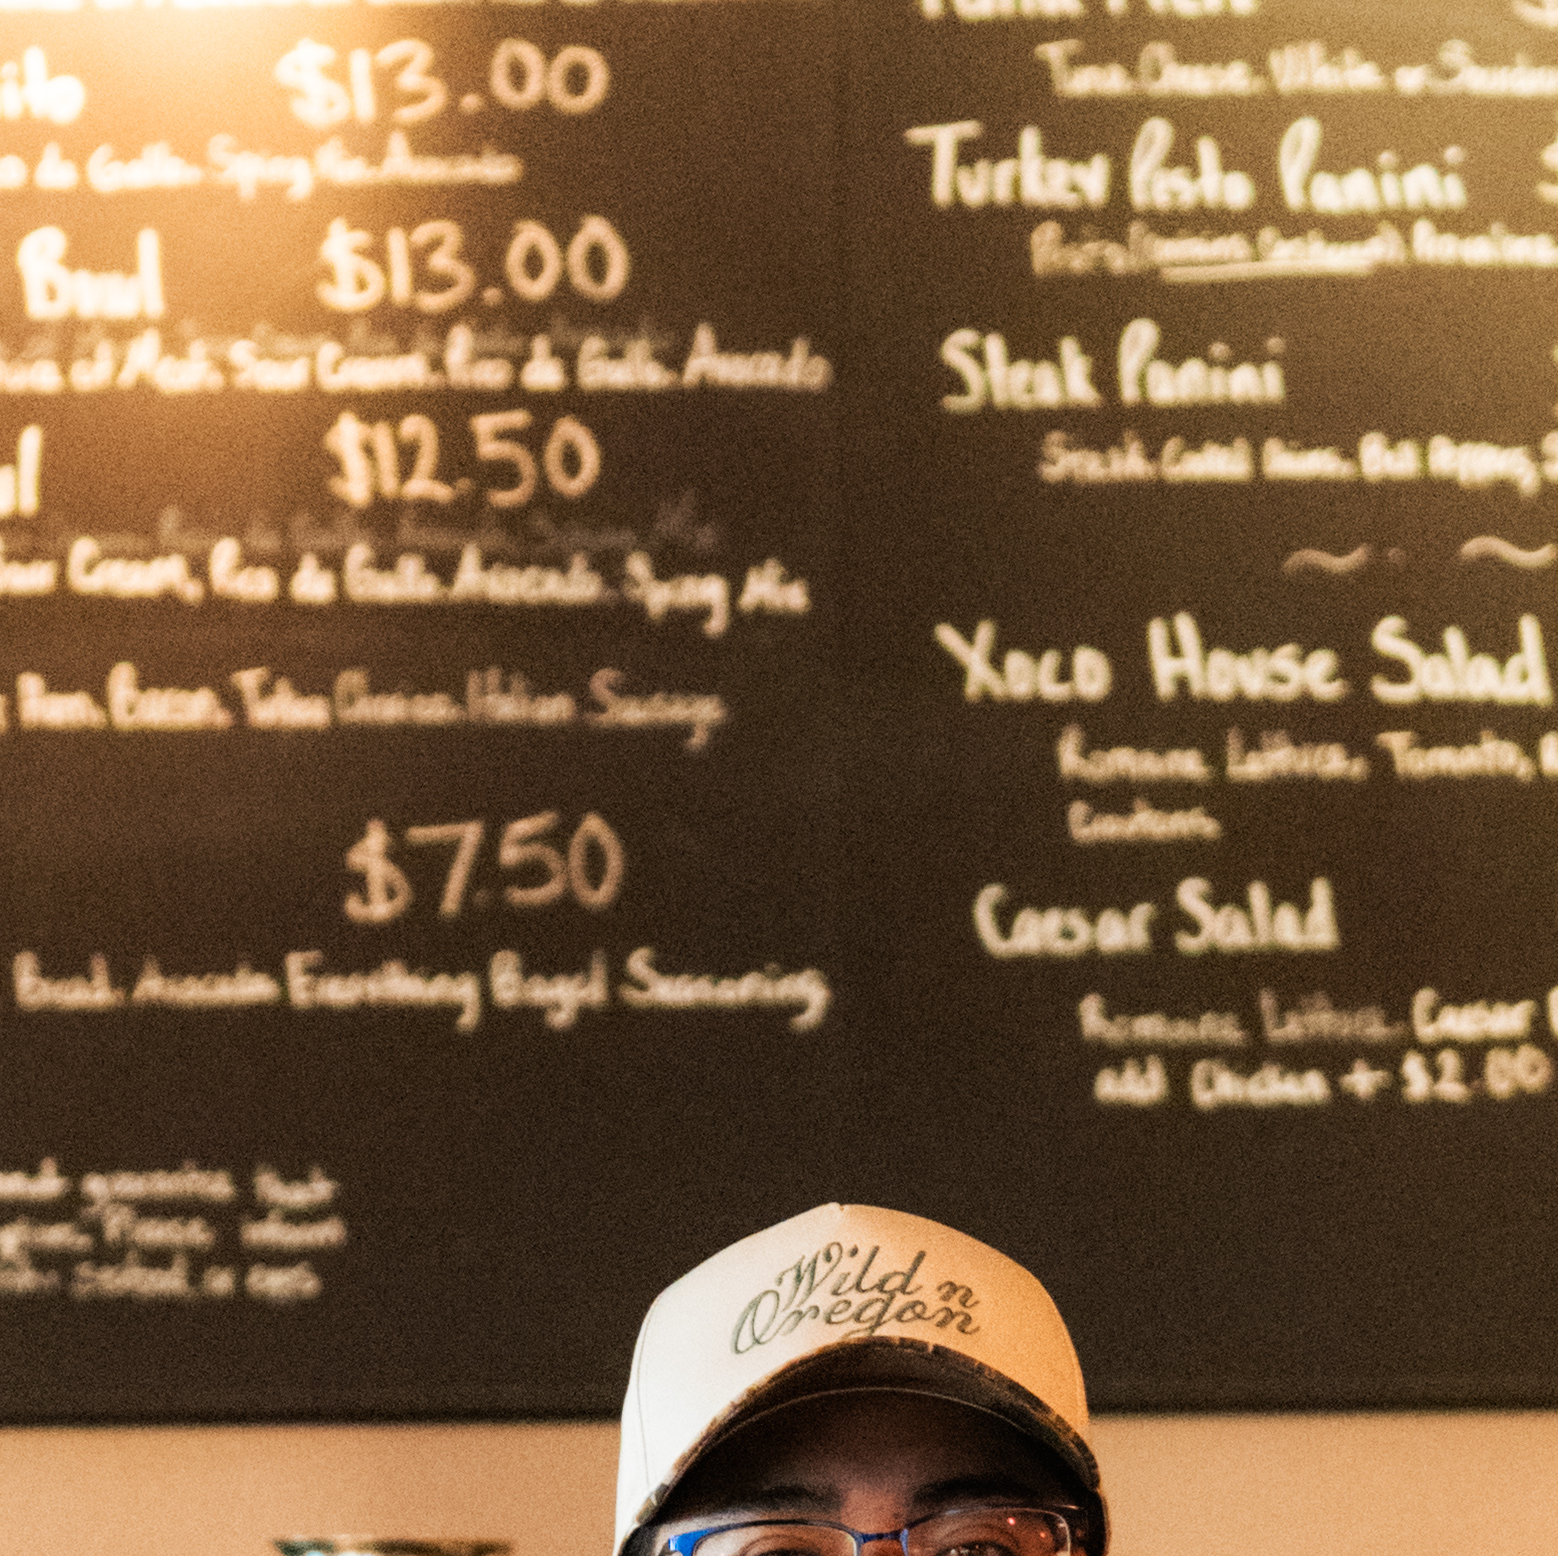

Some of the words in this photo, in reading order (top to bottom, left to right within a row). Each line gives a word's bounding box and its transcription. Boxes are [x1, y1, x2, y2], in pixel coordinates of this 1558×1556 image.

[275, 37, 610, 128] $13.00
[904, 118, 1112, 209] Turkey
[1278, 115, 1469, 213] Panini
[16, 225, 167, 321] Bowl
[316, 213, 632, 313] $13.00
[940, 327, 1103, 414] Steak
[1118, 316, 1288, 406] Panini
[325, 409, 603, 509] $12.50
[934, 618, 1114, 704] Xoco
[1147, 610, 1349, 702] House
[1370, 612, 1554, 706] Salad
[344, 810, 627, 925] $7.50
[972, 882, 1157, 960] Caesar
[1173, 876, 1341, 955] Salad
[489, 946, 611, 1032] Bagel
[731, 1289, 982, 1356] Oregon
[774, 1241, 926, 1310] Wild
